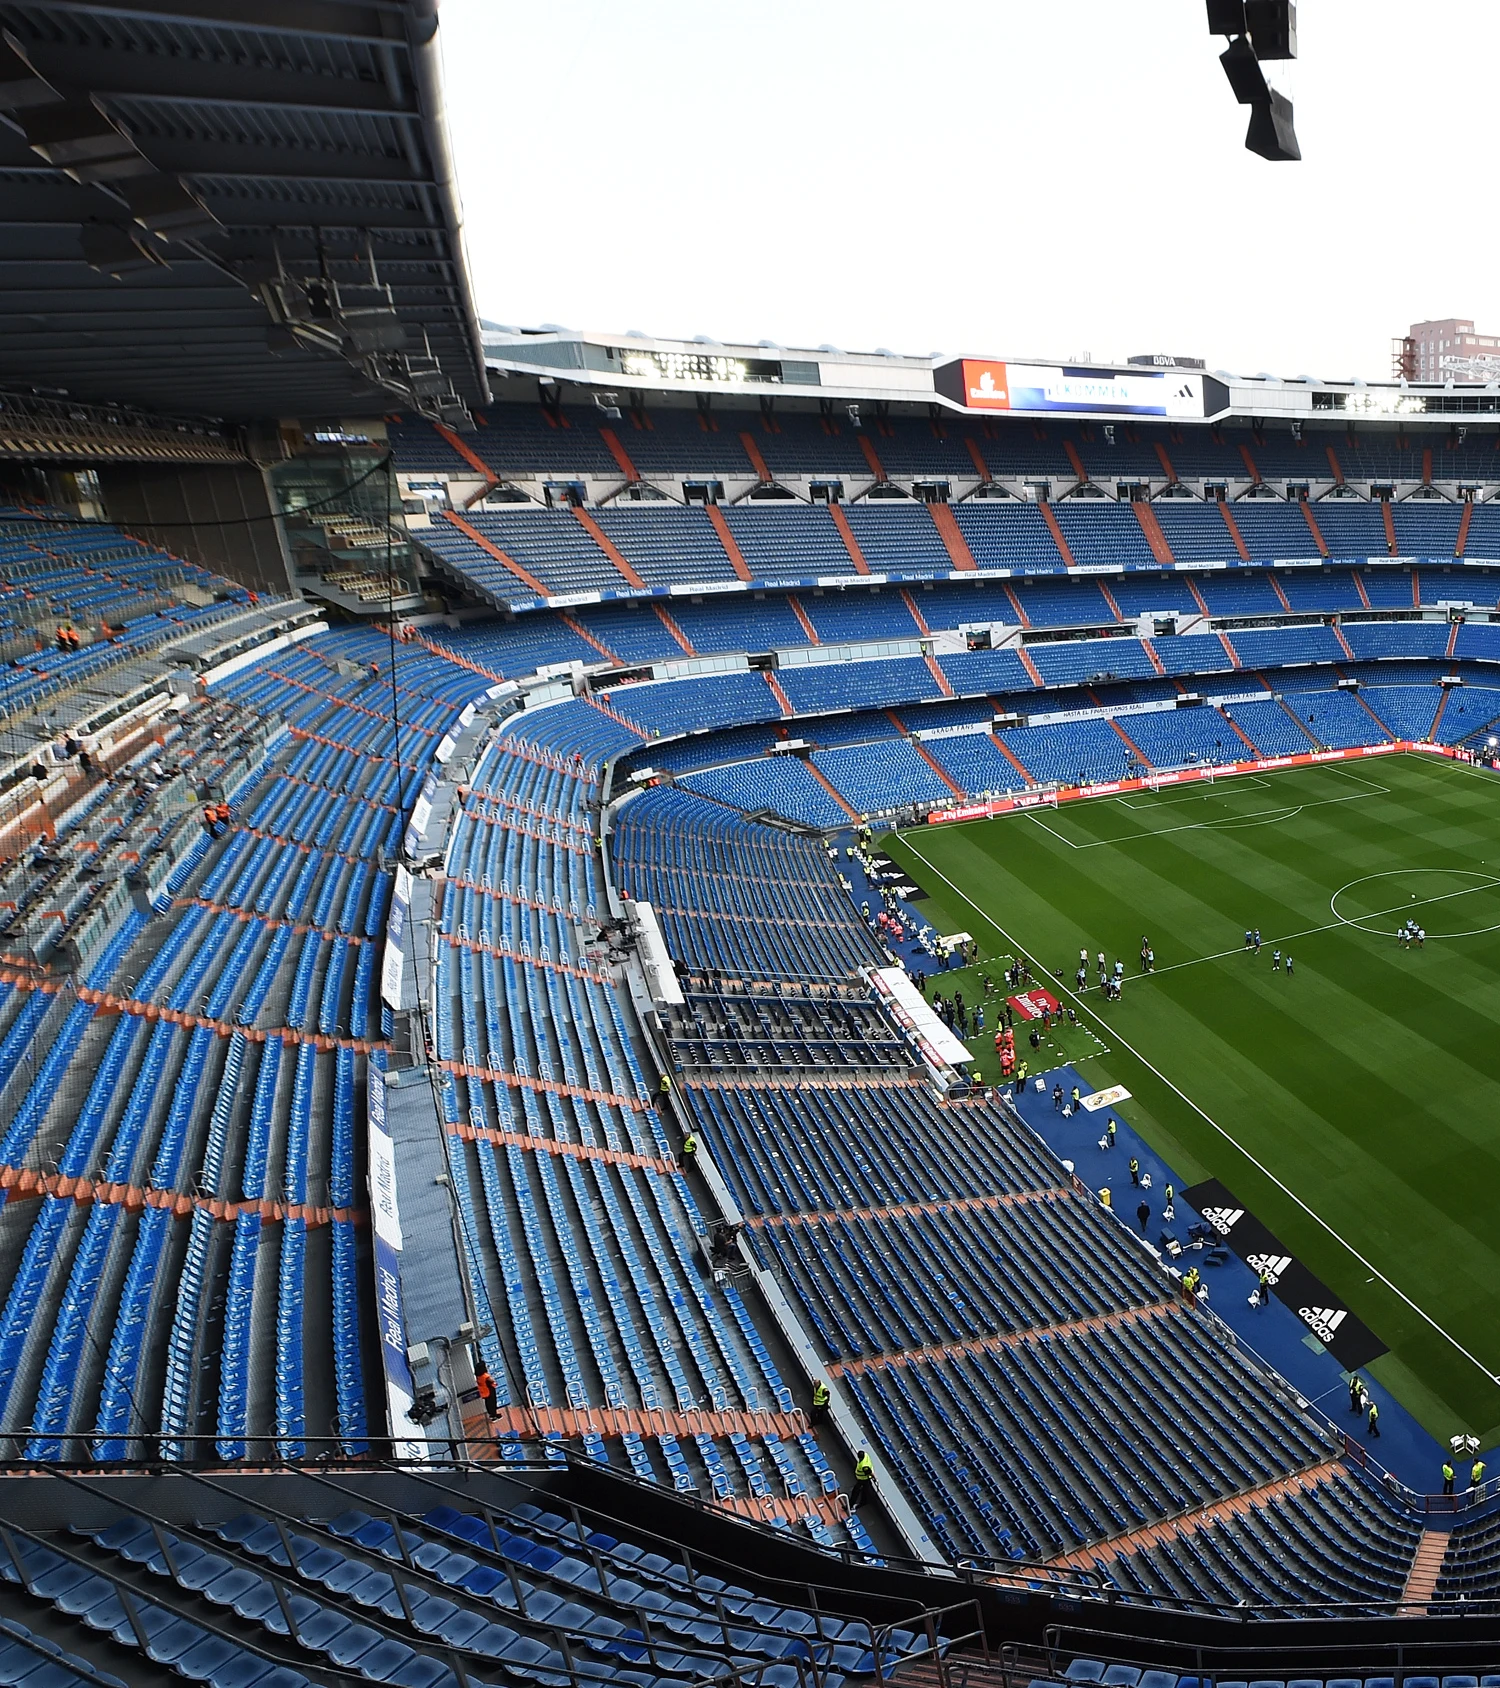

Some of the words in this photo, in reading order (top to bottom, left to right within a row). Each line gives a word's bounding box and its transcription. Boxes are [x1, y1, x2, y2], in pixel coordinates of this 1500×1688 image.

[1201, 1207, 1231, 1236] adidas
[379, 1266, 400, 1320] Madrid
[384, 1318, 404, 1355] Real
[1298, 1307, 1335, 1342] adidas
